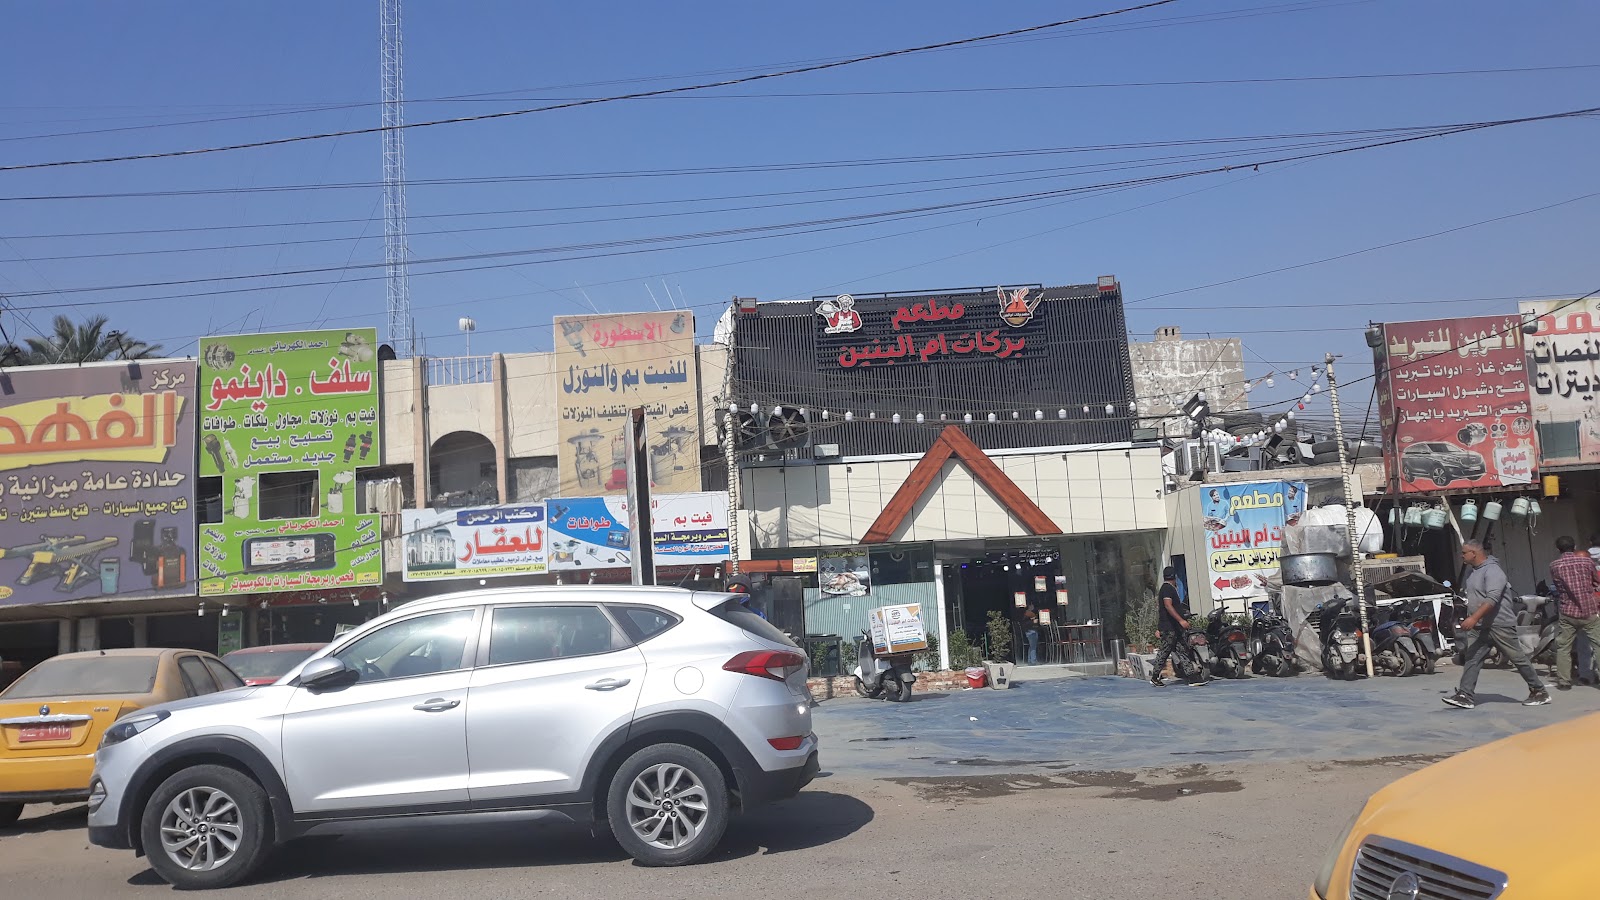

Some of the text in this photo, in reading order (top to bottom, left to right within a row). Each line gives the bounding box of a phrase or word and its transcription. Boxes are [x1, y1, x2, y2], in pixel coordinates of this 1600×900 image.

[890, 298, 966, 330] مطعم
[592, 320, 663, 347] الاسطورة
[1389, 318, 1521, 361] الأخوين للتبريد
[308, 339, 328, 348] احمد
[838, 330, 1026, 368] بركات ام البنين
[149, 369, 186, 390] مركز
[563, 360, 688, 394] للفيت بم والنوزل
[1395, 358, 1523, 383] شحن غاز ادوات تبريد
[206, 358, 372, 411] سلف داينمو
[1496, 380, 1525, 398] فتح
[1396, 386, 1450, 402] السيارات
[562, 405, 596, 422] النوزلات
[668, 401, 689, 418] فحص
[1399, 401, 1528, 424] فحص التبريد بالجهاز
[203, 406, 376, 432] فيت بم نوزلات مجاول بلكات طوافات
[251, 430, 333, 449] تصليح بيع
[243, 451, 336, 469] جديد مستعمل
[8, 475, 78, 501] ميزانية
[82, 471, 128, 491] عامة
[132, 470, 186, 489] حدادة
[49, 504, 70, 517] مشط
[72, 503, 89, 520] فتح
[103, 500, 143, 516] السيارات
[144, 501, 168, 516] جميع
[170, 497, 188, 515] فتح
[1229, 490, 1284, 516] مطعم
[20, 507, 47, 522] ستيرن
[322, 518, 345, 527] احمد
[466, 508, 538, 525] مكتب الرحمن
[567, 516, 612, 531] طوافات
[674, 512, 712, 527] فيت بم
[355, 519, 373, 532] سلف
[1254, 523, 1269, 546] أم
[361, 529, 376, 543] فيت
[457, 526, 544, 564] للعقار
[654, 530, 727, 544] فحص وبرمجة السي
[1211, 529, 1251, 549] البنين
[1214, 551, 1281, 567] الزبائن الكرام
[272, 573, 305, 588] السيارات
[339, 570, 354, 584] فحص
